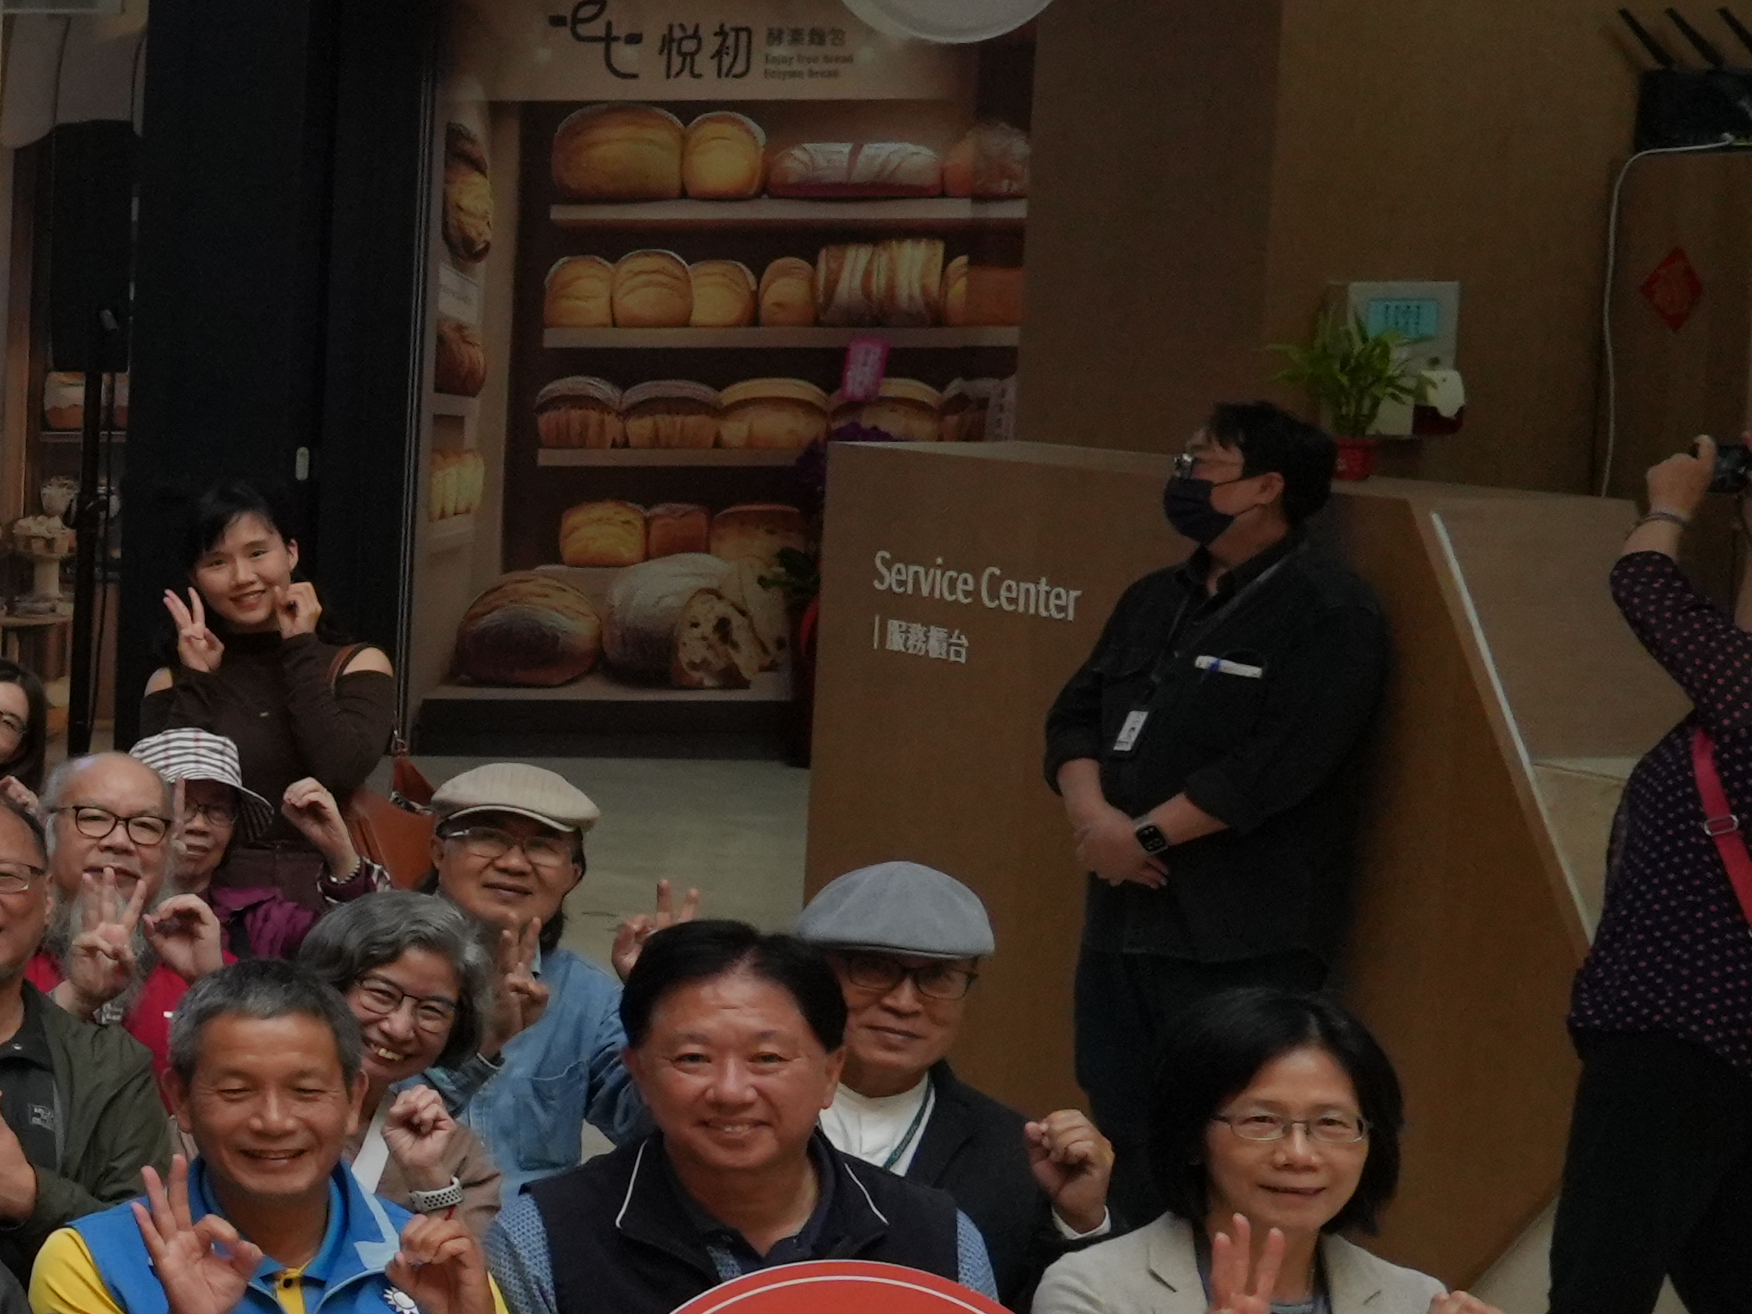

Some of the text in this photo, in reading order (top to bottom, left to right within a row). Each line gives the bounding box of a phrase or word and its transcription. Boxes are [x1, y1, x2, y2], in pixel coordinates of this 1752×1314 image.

[873, 550, 1083, 622] Service Center
[886, 619, 969, 664] 服務櫃台
